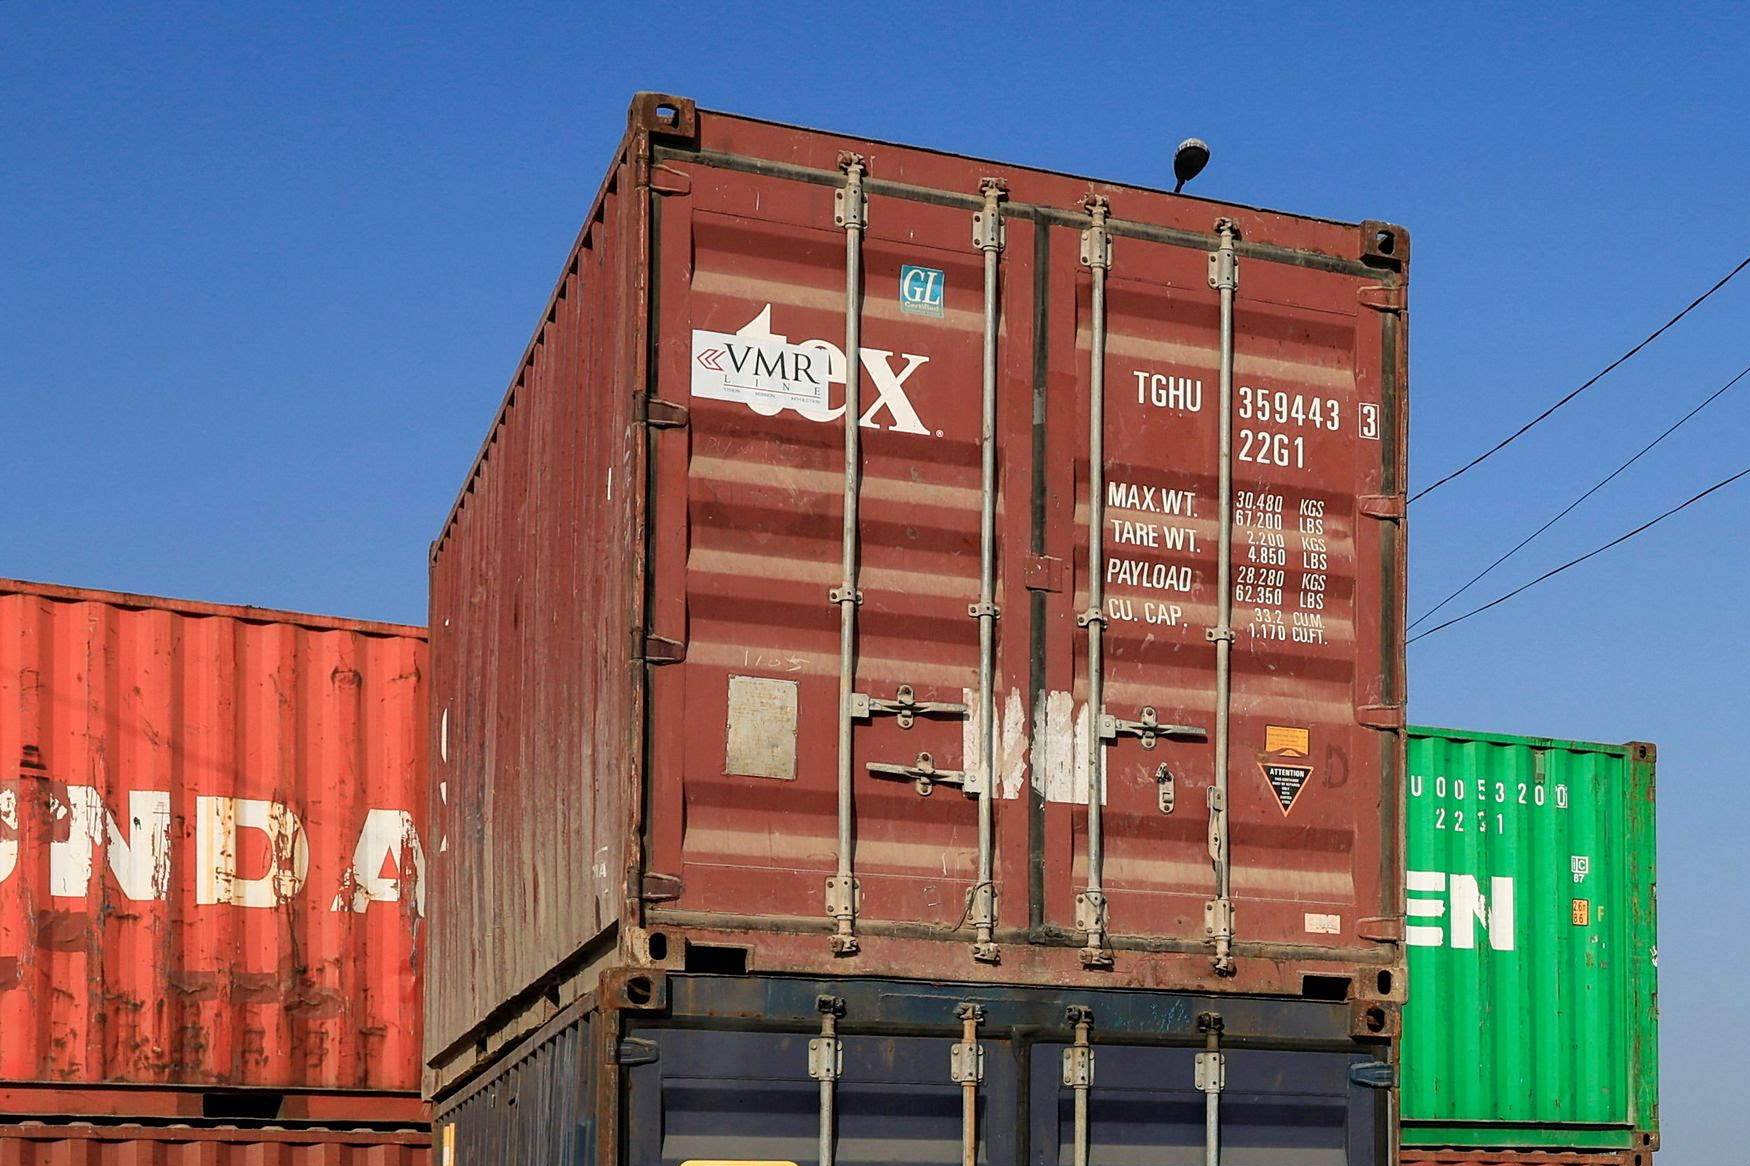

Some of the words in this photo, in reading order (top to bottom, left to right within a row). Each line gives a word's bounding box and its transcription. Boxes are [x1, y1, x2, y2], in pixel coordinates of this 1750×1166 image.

[904, 269, 941, 305] GL
[724, 343, 820, 384] VMR
[1133, 371, 1202, 412] TGHU
[1238, 386, 1341, 432] 359443
[1362, 404, 1378, 438] 3
[1238, 428, 1305, 468] 22G1
[1236, 491, 1284, 512] 30.480
[1299, 498, 1325, 518] KGS
[1111, 519, 1159, 549] TARE
[1162, 525, 1201, 553] WT.
[1246, 531, 1285, 549] 2.200
[1301, 535, 1327, 553] KGS
[1235, 510, 1283, 531] 67.200
[1299, 516, 1324, 536] LBS
[1247, 547, 1286, 567] 4.850
[1303, 551, 1327, 571] LBS
[1106, 558, 1193, 592] PAYLOAD
[1236, 566, 1285, 588] 28.280
[1301, 573, 1327, 592] KGS
[1235, 585, 1283, 606] 62.350
[1299, 591, 1325, 610] LBS
[1108, 598, 1139, 623] CU.
[1144, 602, 1189, 629] CAP.
[1253, 608, 1284, 625] 33.2
[1292, 612, 1326, 630] CU.M.
[1248, 622, 1286, 642] 1.170
[1269, 768, 1305, 778] ATTENTION
[1573, 873, 1585, 884] 87
